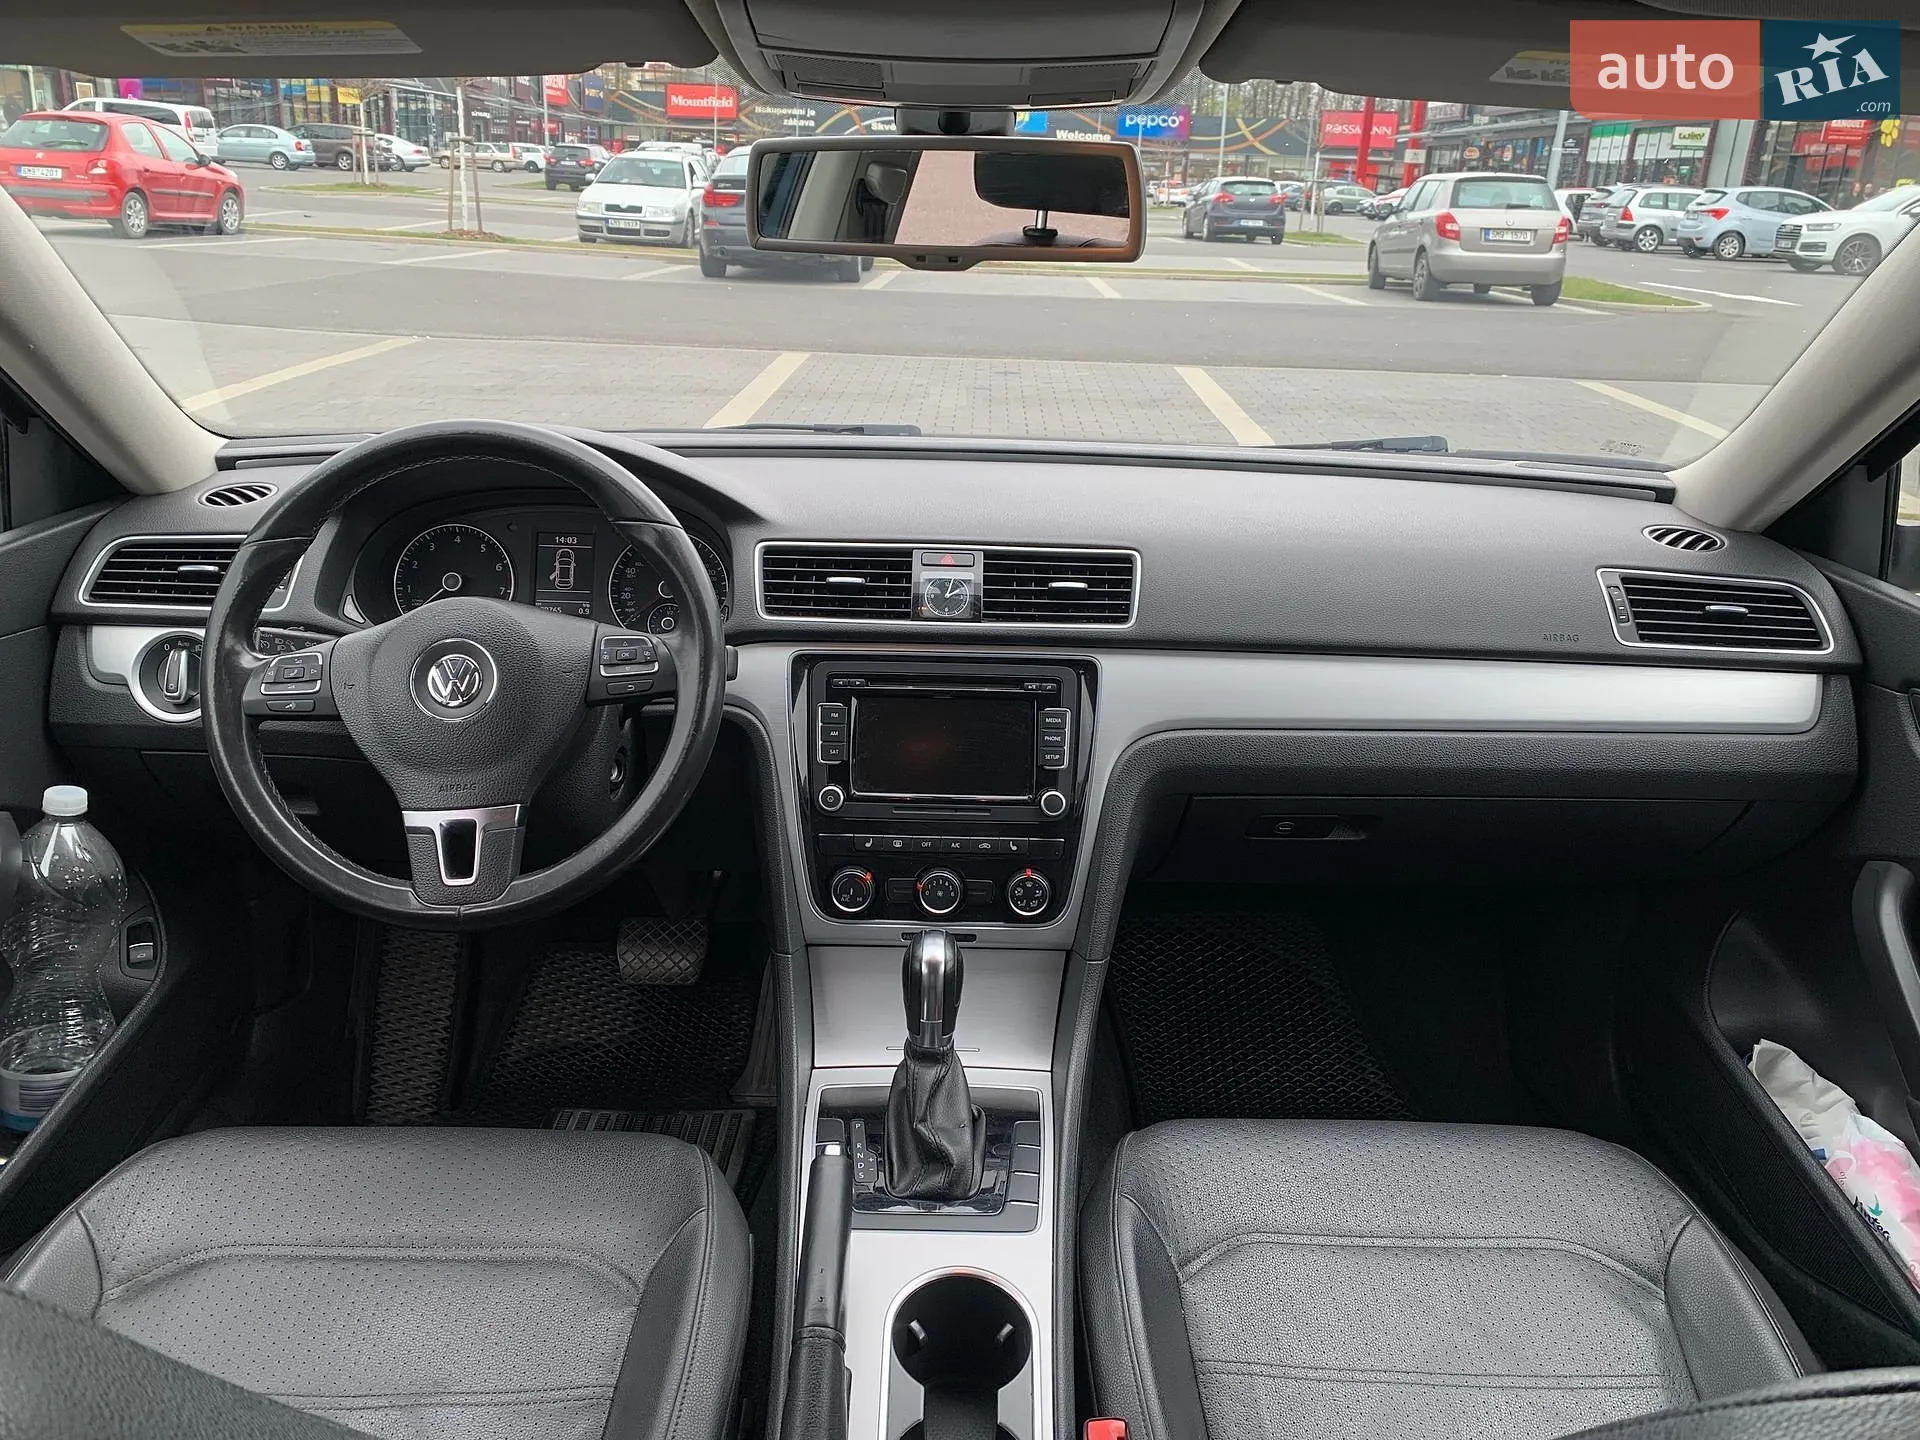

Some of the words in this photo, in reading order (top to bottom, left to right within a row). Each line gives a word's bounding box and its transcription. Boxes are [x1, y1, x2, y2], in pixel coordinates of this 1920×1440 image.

[671, 95, 733, 108] Mountfield
[783, 116, 815, 127] zábava
[1056, 129, 1112, 142] Welcome
[555, 536, 577, 544] 14:03
[1543, 633, 1580, 642] AIRBAG
